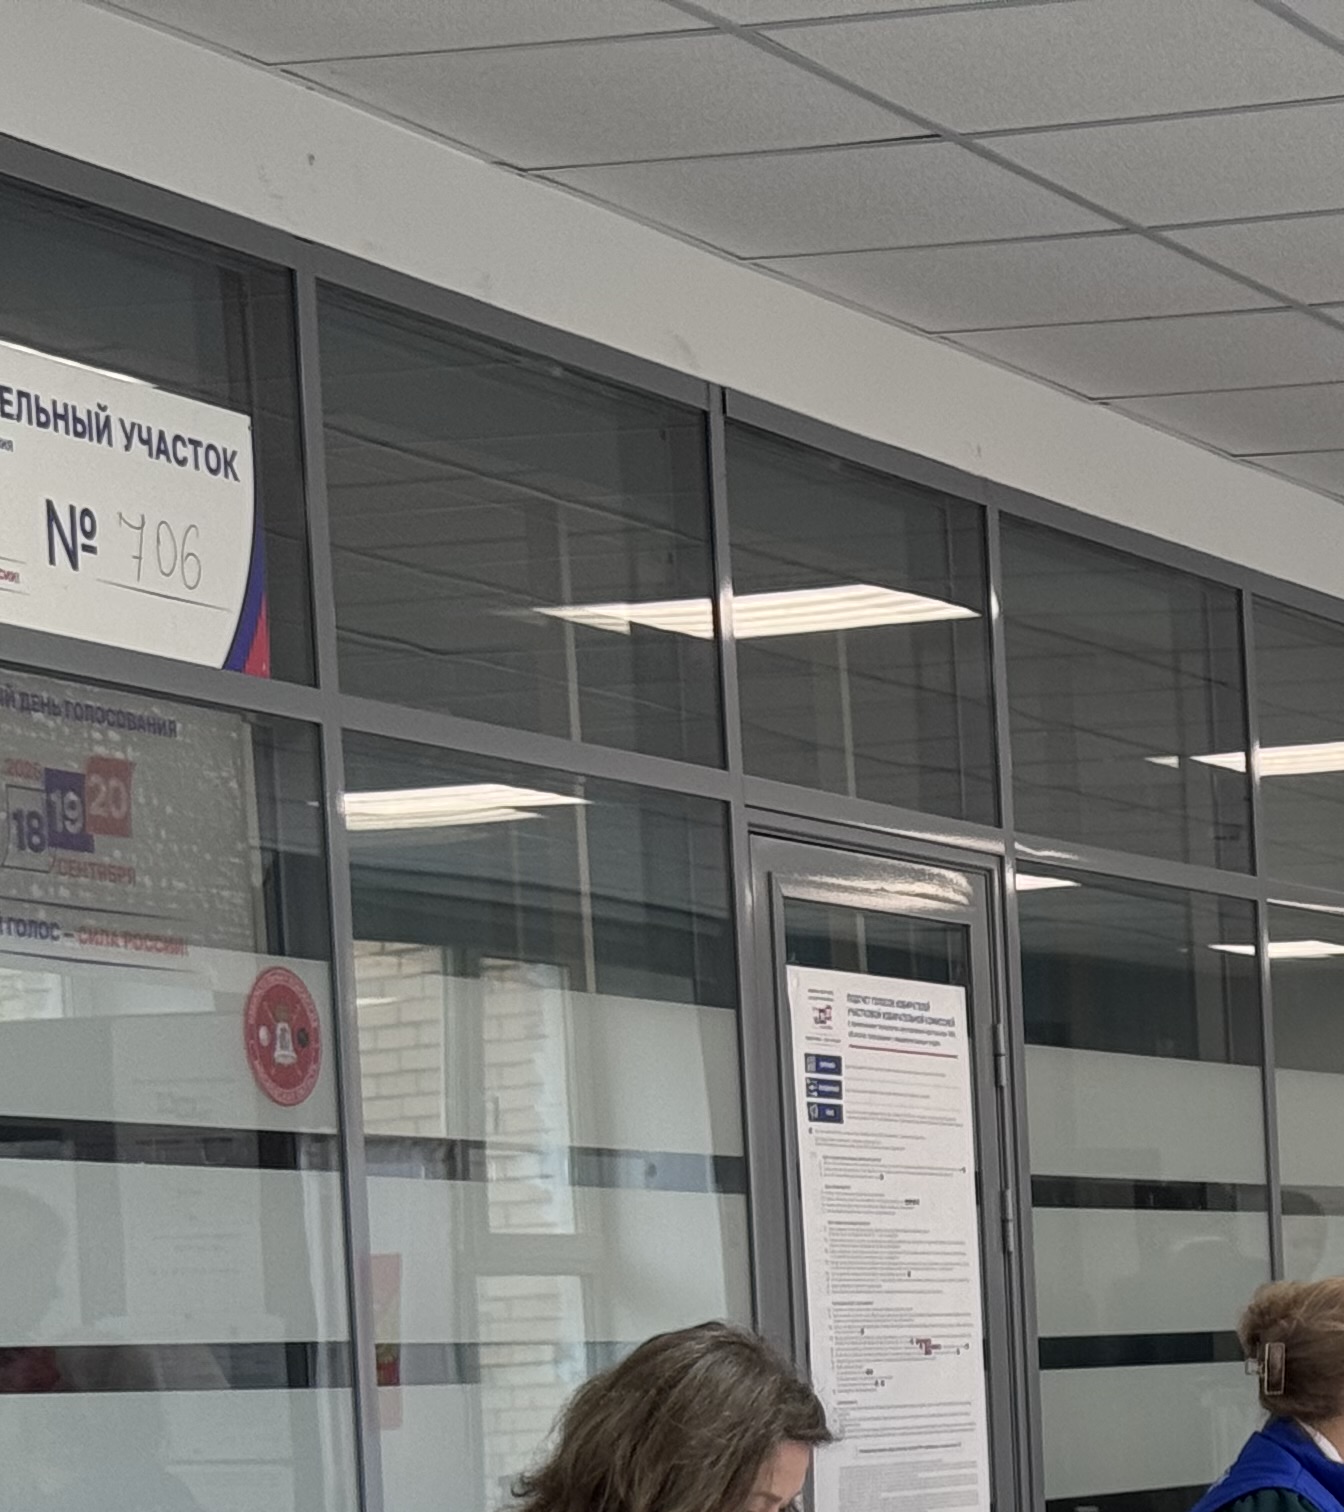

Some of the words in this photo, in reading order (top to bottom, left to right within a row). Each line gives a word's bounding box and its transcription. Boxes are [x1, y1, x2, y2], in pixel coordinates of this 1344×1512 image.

[119, 417, 240, 482] УЧАСТОК
[46, 498, 98, 571] №
[117, 511, 202, 590] 706
[20, 691, 62, 717] ДЕНЬ
[64, 700, 178, 738] ГОЛОСОВАНИЯ
[12, 809, 47, 853] 18
[50, 790, 83, 834] 19
[88, 774, 127, 819] 20
[8, 917, 61, 942] ГОЛОС
